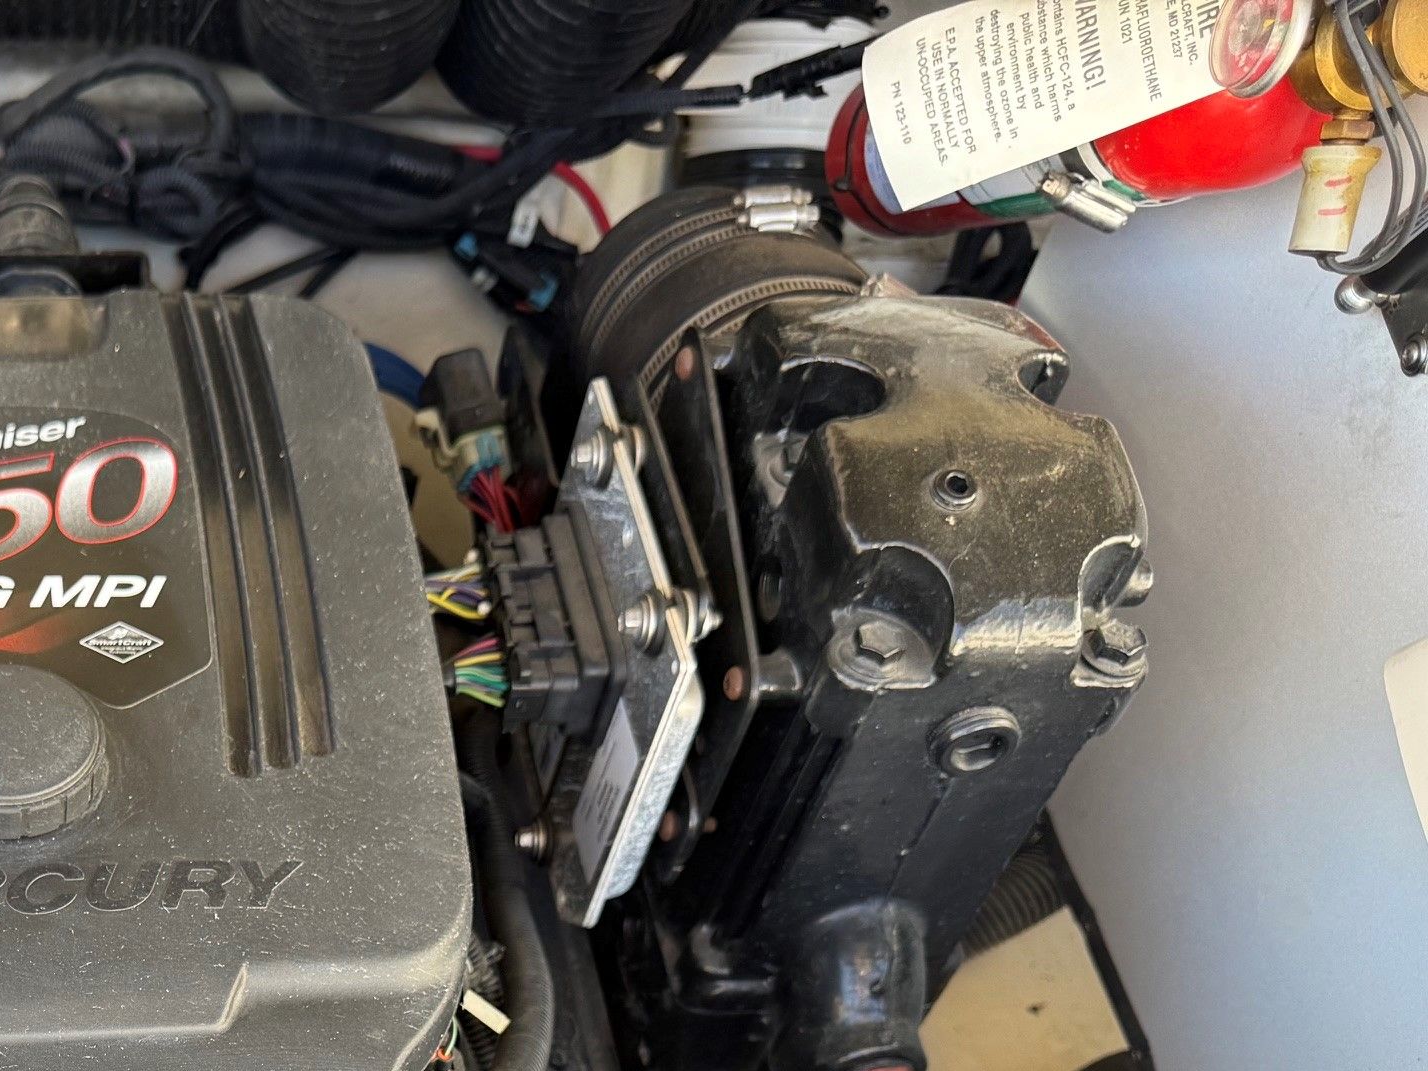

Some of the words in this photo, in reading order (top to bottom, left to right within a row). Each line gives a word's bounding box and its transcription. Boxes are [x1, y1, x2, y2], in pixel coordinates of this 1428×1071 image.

[975, 16, 985, 33] the
[1019, 12, 1033, 46] public
[1120, 17, 1133, 44] 1021
[1168, 10, 1178, 28] MD
[932, 41, 943, 66] USE
[945, 27, 957, 59] E.P.A.
[975, 35, 987, 67] upper
[990, 9, 1003, 66] destroying
[1075, 0, 1106, 91] ARNING!
[1170, 28, 1183, 58] 21237
[1187, 41, 1199, 66] INC.
[934, 67, 945, 81] IN
[996, 66, 1006, 87] the
[1006, 22, 1024, 93] environment
[1016, 94, 1027, 110] by
[1025, 46, 1040, 84] health
[1041, 46, 1054, 82] which
[1056, 36, 1074, 101] HCFC-124,
[1067, 103, 1076, 111] a
[891, 80, 902, 99] PN
[916, 37, 936, 119] UN-OCCUPIED
[930, 122, 948, 166] AREAS.
[948, 60, 968, 126] ACCEPTED
[981, 70, 1002, 142] atmosphere.
[1032, 86, 1044, 110] and
[1047, 83, 1062, 122] harms
[895, 101, 912, 144] 123-110
[937, 82, 960, 149] NORMALLY
[1000, 89, 1013, 125] ozone
[962, 128, 976, 154] FOR
[1009, 126, 1018, 139] in
[30, 575, 167, 608] MPI
